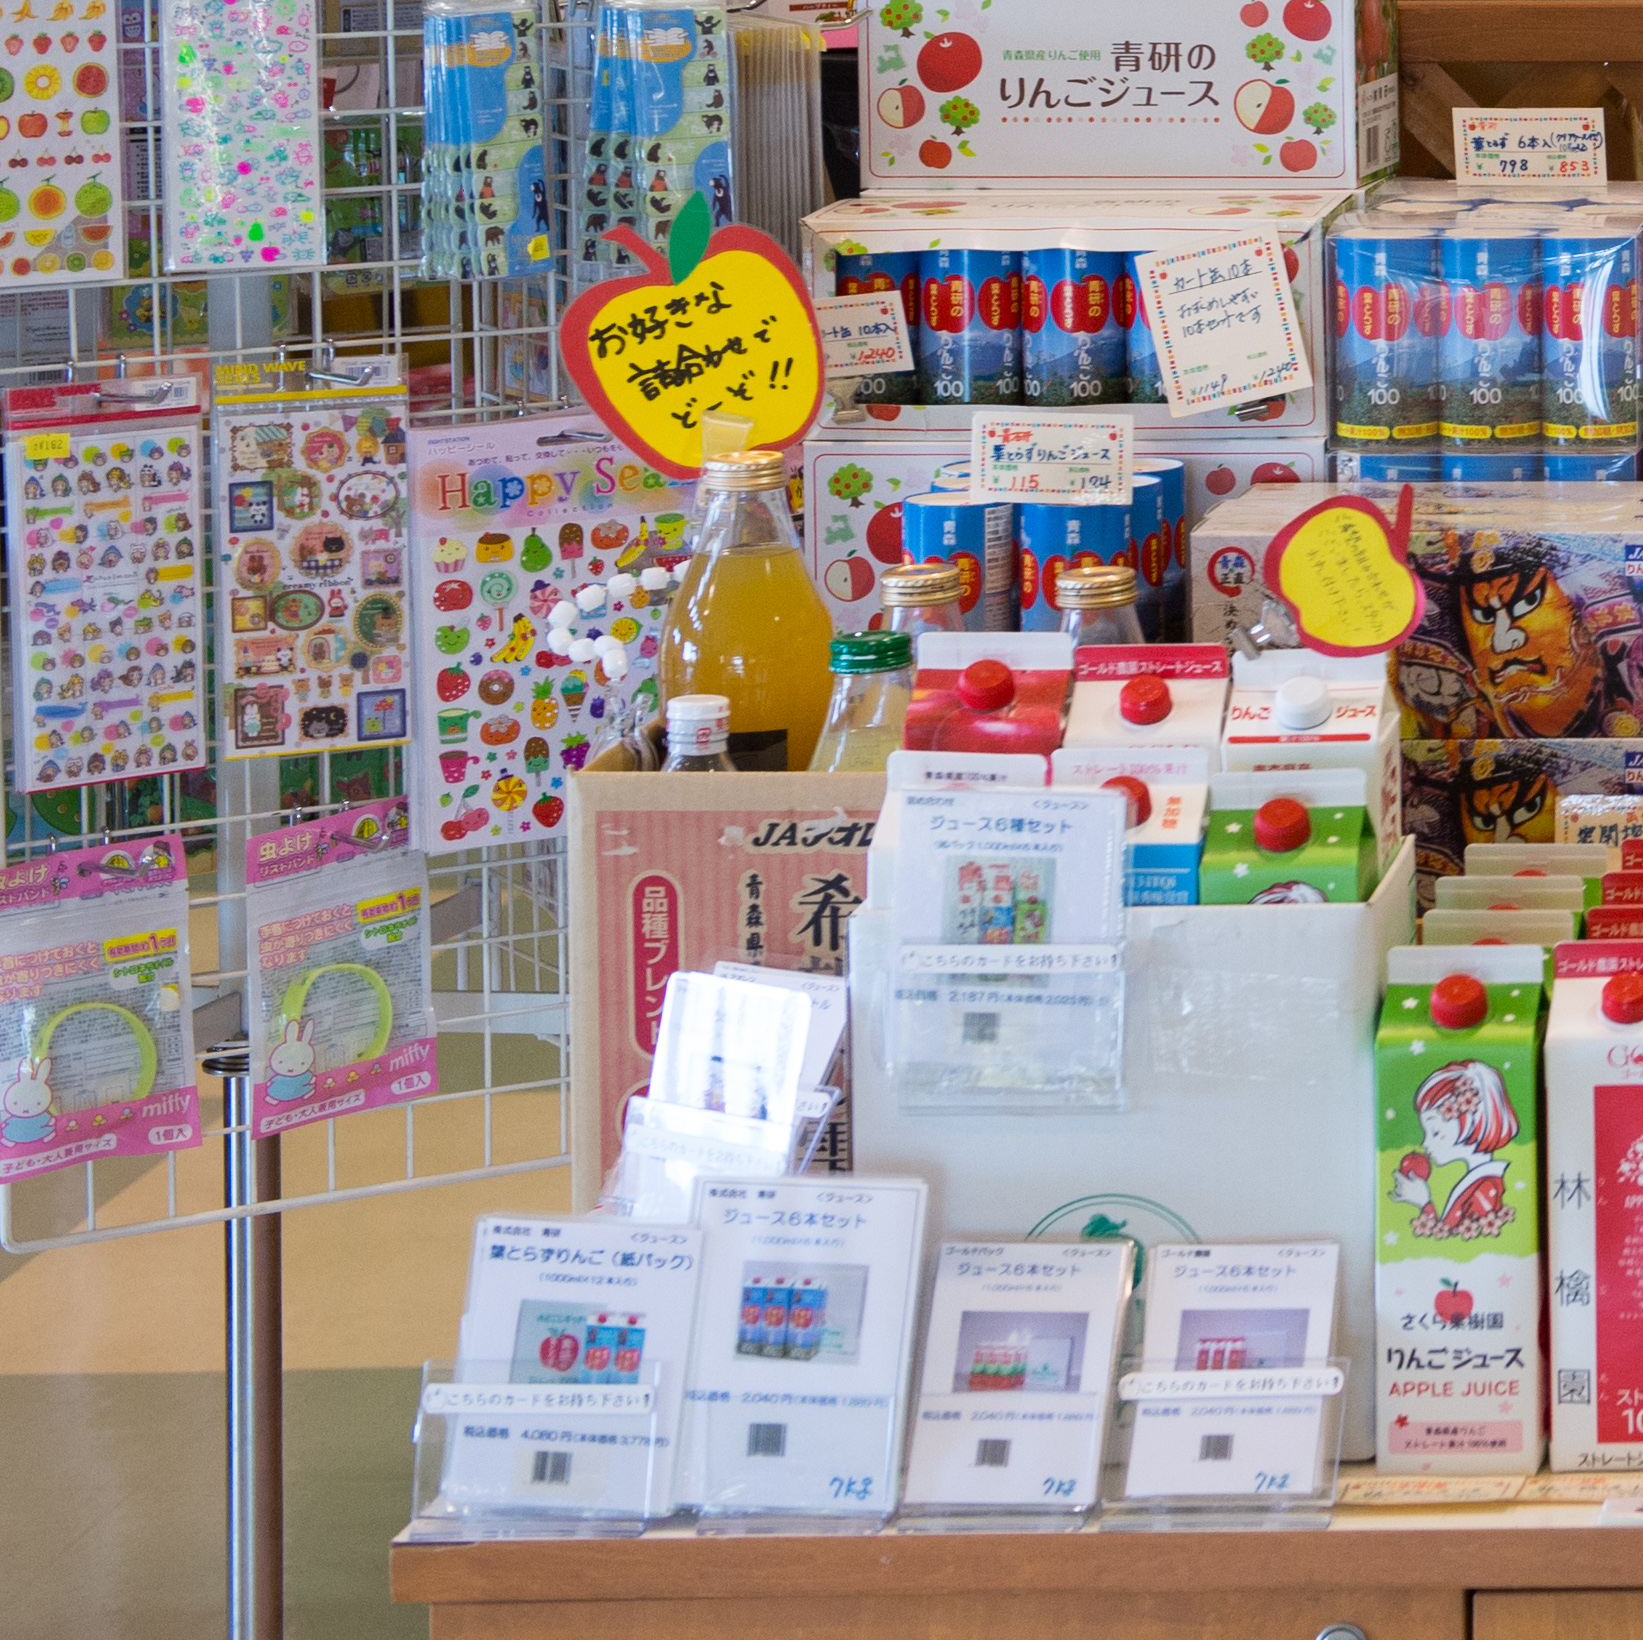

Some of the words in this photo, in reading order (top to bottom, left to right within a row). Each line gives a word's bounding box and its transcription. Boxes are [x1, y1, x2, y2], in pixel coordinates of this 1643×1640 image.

[1108, 39, 1217, 74] 青研の
[998, 77, 1221, 110] りんごジュース
[1500, 158, 1529, 173] 798
[1559, 158, 1590, 172] 853
[436, 469, 581, 511] Happy
[593, 455, 698, 496] Sea
[388, 1043, 431, 1072] miffy
[141, 1092, 191, 1118] miffy
[1401, 1312, 1504, 1332] さくら果樹園
[1386, 1347, 1525, 1371] りんごジュース
[1388, 1380, 1454, 1397] APPLE
[1462, 1379, 1519, 1397] JUICE
